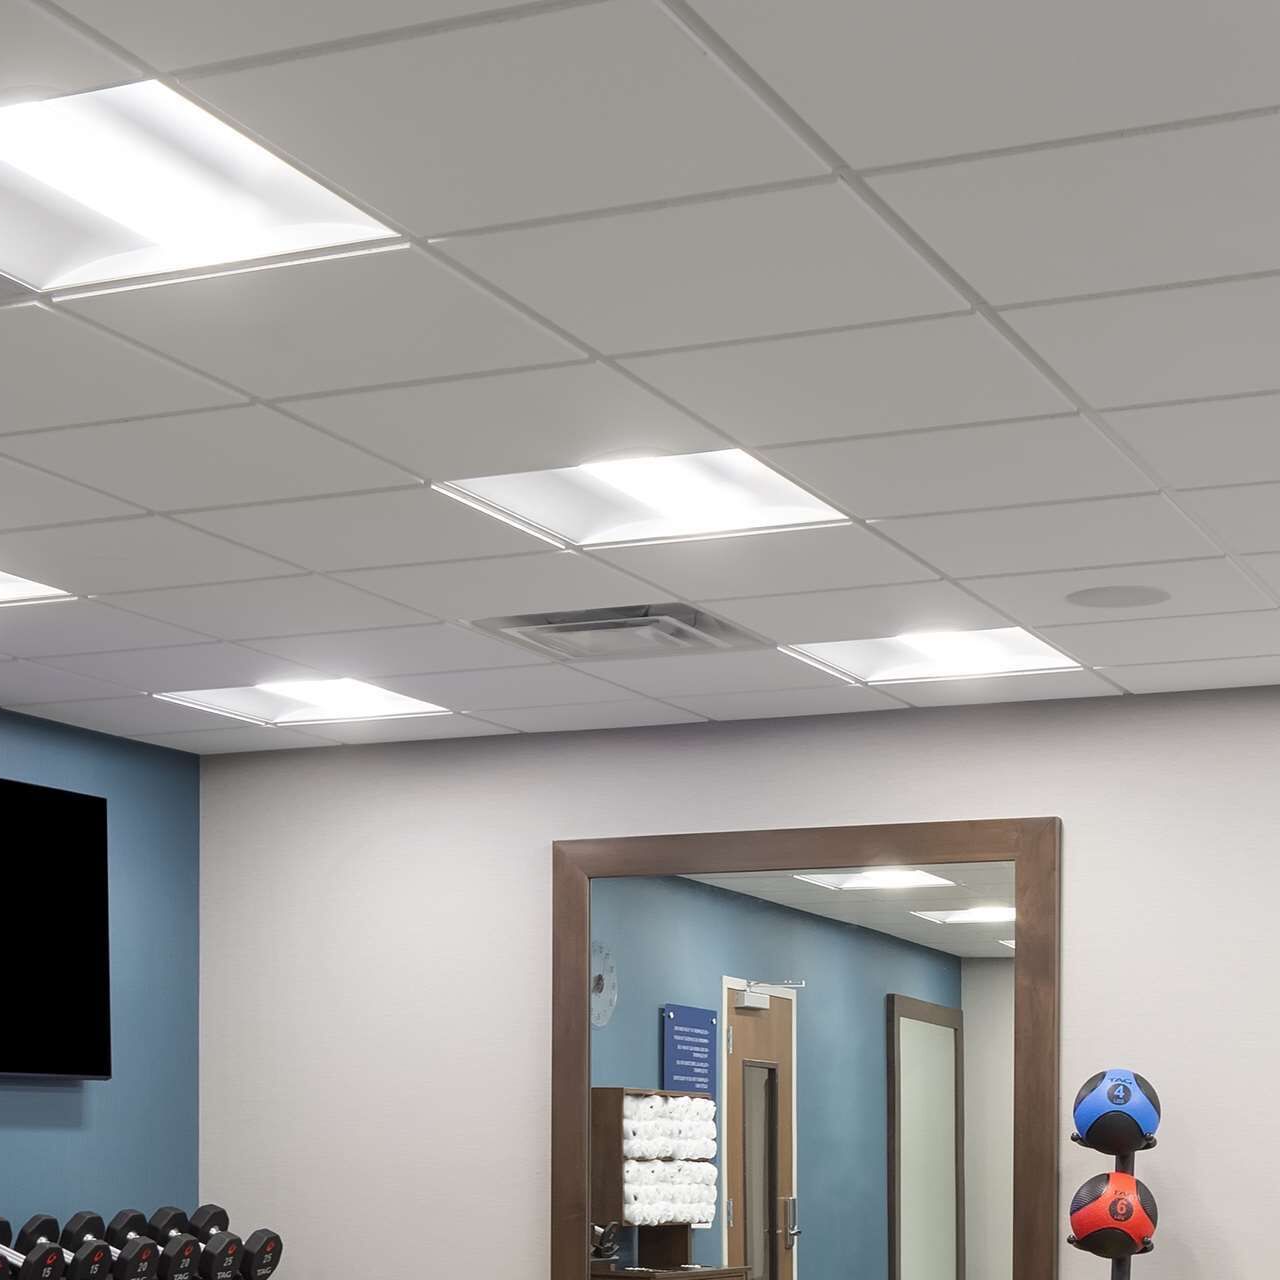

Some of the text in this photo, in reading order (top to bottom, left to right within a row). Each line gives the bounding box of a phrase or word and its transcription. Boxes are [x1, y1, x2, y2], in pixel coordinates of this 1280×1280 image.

[1114, 1085, 1125, 1098] 4
[1117, 1200, 1127, 1214] 6
[41, 1266, 53, 1278] 15
[89, 1263, 100, 1274] 15
[257, 1266, 272, 1277] TAG
[216, 1270, 233, 1280] TAG
